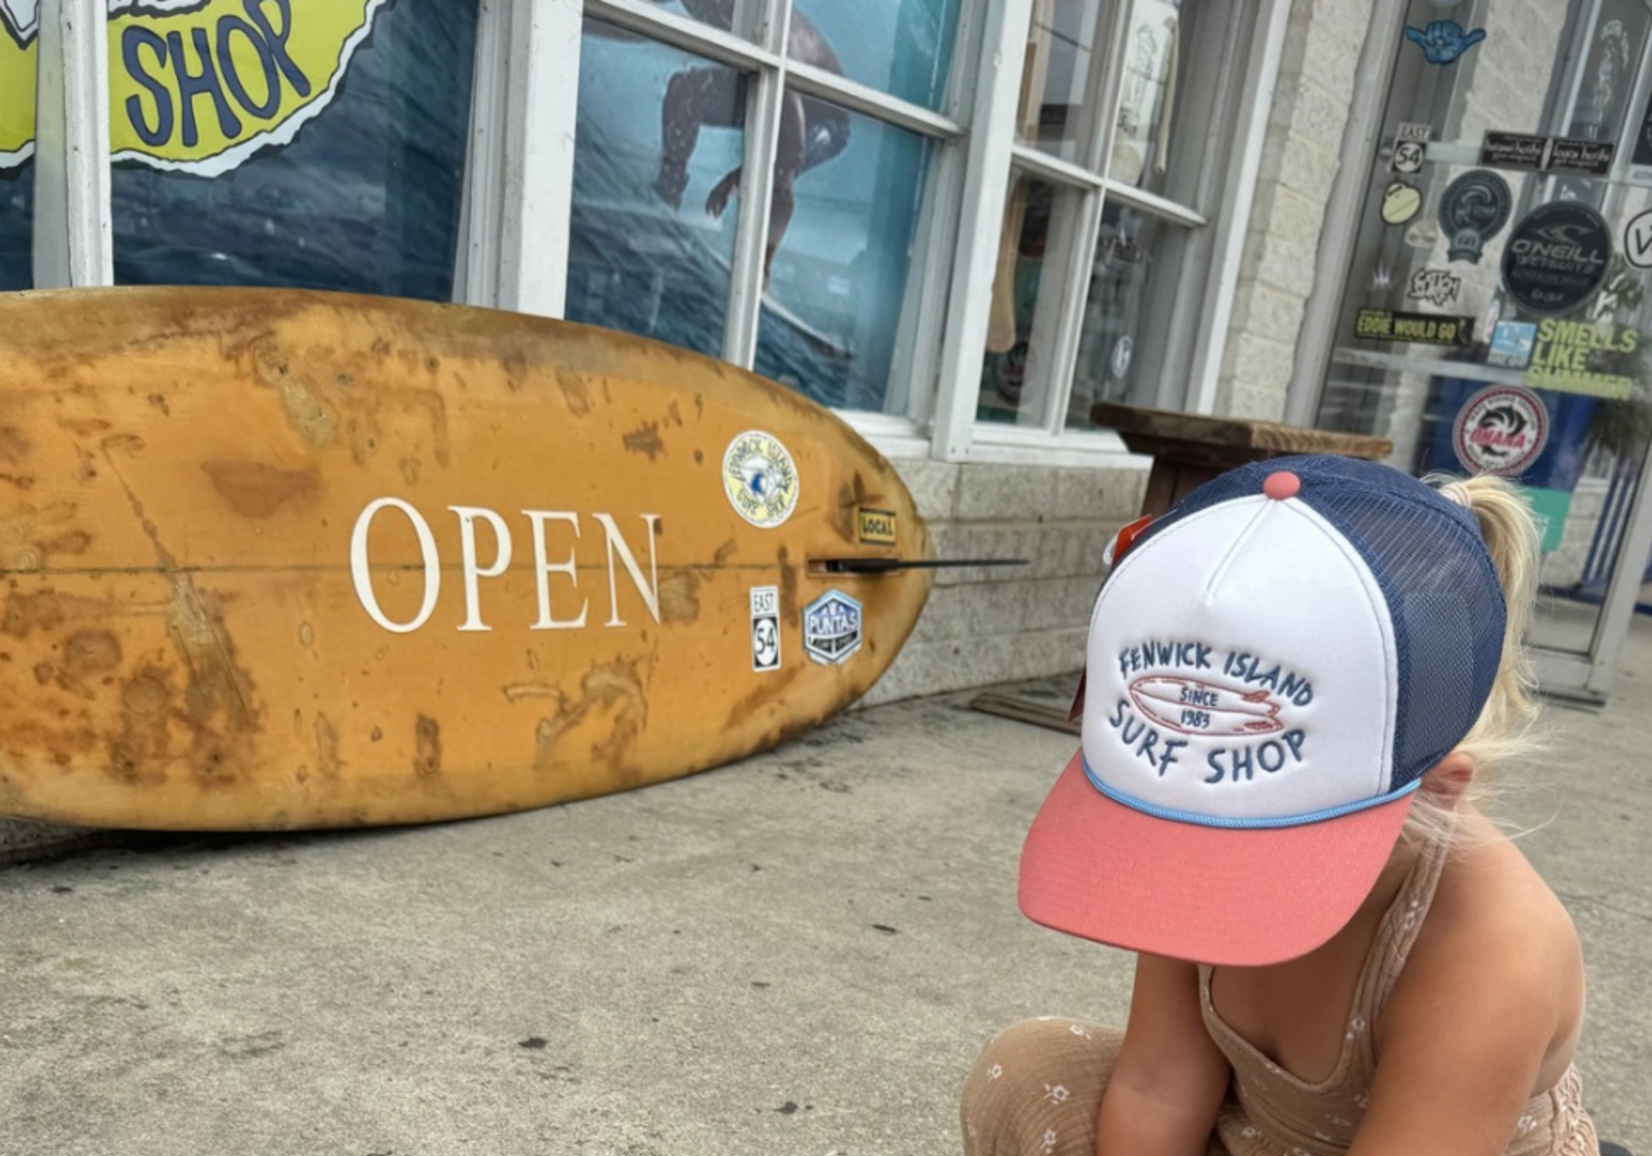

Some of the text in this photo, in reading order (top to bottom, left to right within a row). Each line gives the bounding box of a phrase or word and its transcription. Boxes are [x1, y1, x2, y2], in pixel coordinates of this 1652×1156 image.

[122, 0, 310, 147] SHOP
[1396, 146, 1421, 166] 54
[1357, 315, 1457, 341] EDDIE WOULD GO
[1537, 317, 1638, 353] SMELLS
[1531, 341, 1589, 370] LIKE
[863, 518, 894, 537] LOCAL
[350, 496, 662, 634] OPEN
[753, 592, 775, 613] EAST
[756, 626, 776, 655] 54
[1119, 640, 1314, 707] FENWICK ISLAND
[1179, 686, 1219, 707] SINCE
[1180, 709, 1211, 729] 1983
[1109, 698, 1306, 784] SURF SHOP
